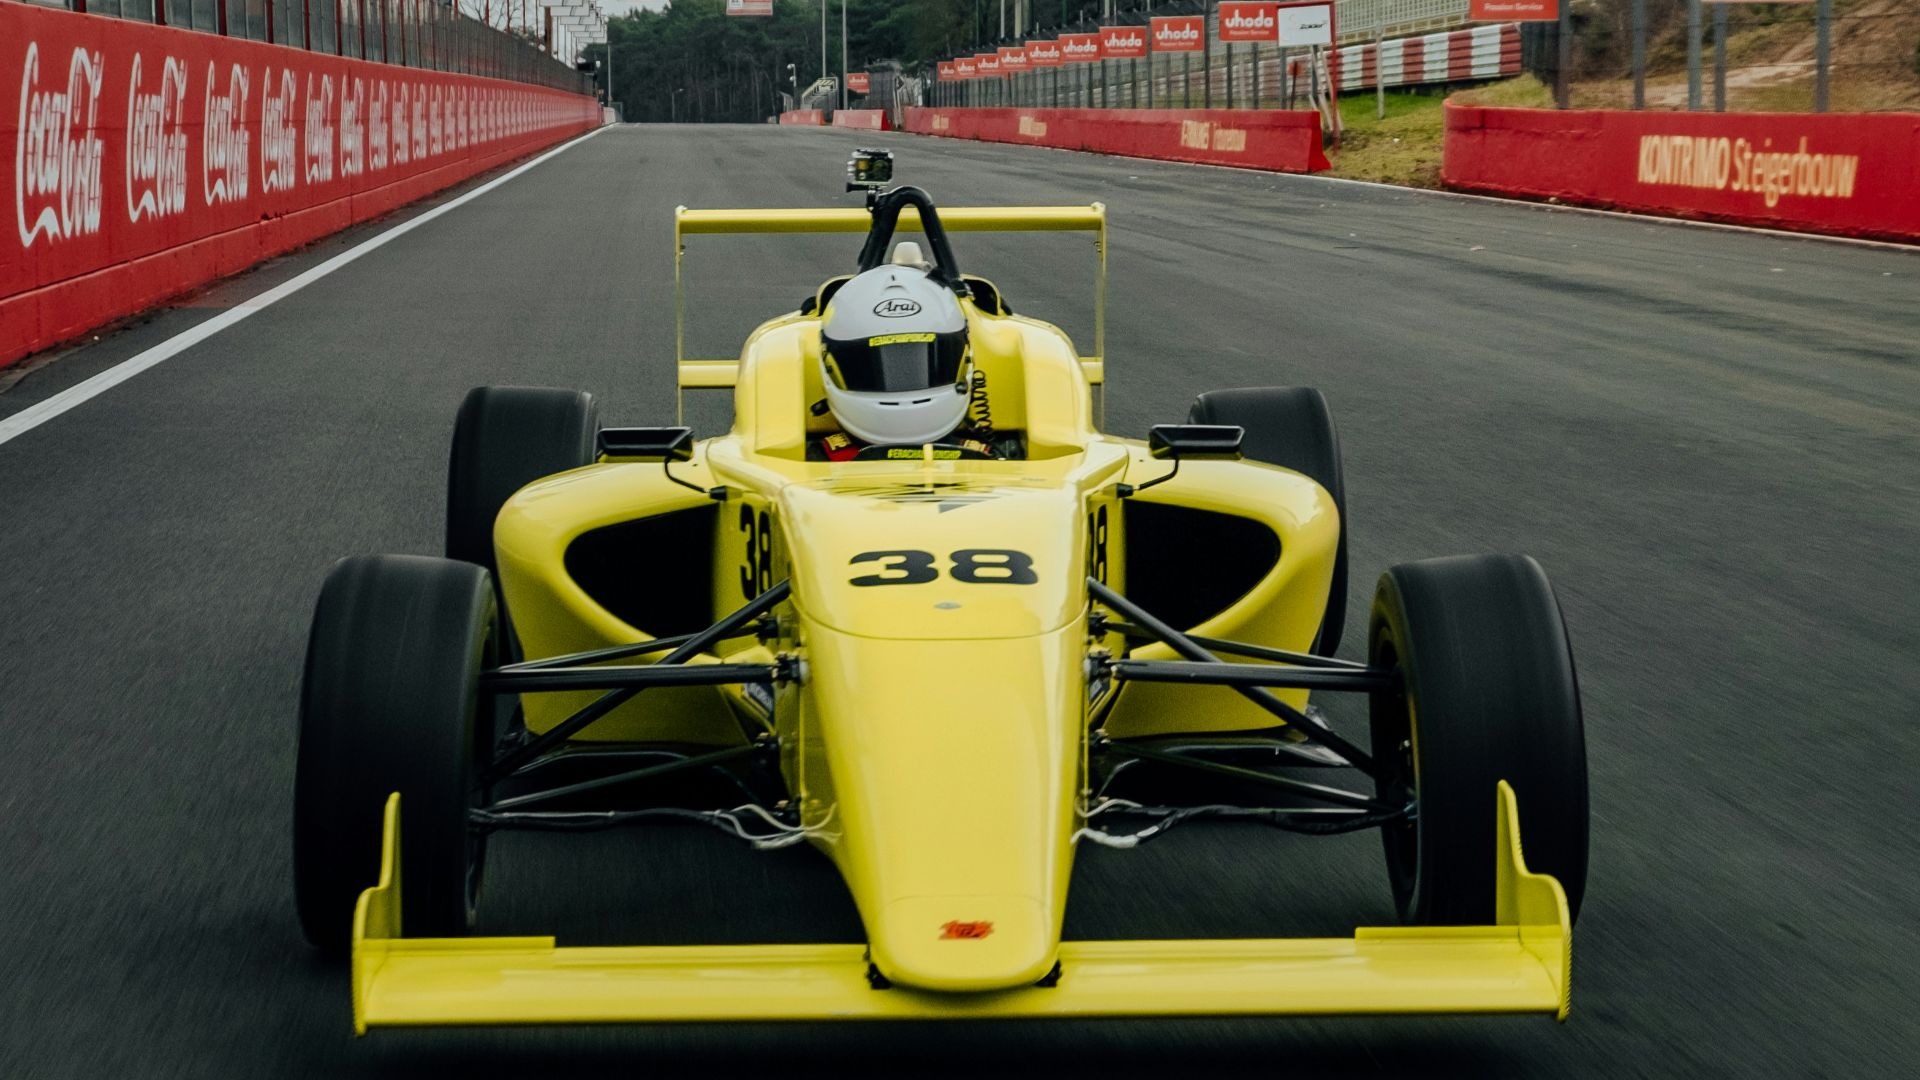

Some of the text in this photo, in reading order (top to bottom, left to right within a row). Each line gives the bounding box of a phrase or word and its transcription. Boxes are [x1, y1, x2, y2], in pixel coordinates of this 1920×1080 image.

[1225, 9, 1274, 28] uhoda
[1104, 32, 1143, 47] uhoda
[1155, 22, 1199, 40] uhoda
[1063, 38, 1098, 53] uhoda
[16, 41, 104, 248] Coca-Cola
[1638, 135, 1859, 208] KONTRIMO Steigerbouw
[879, 301, 916, 313] Arai
[740, 502, 773, 602] 38
[849, 548, 1039, 588] 38
